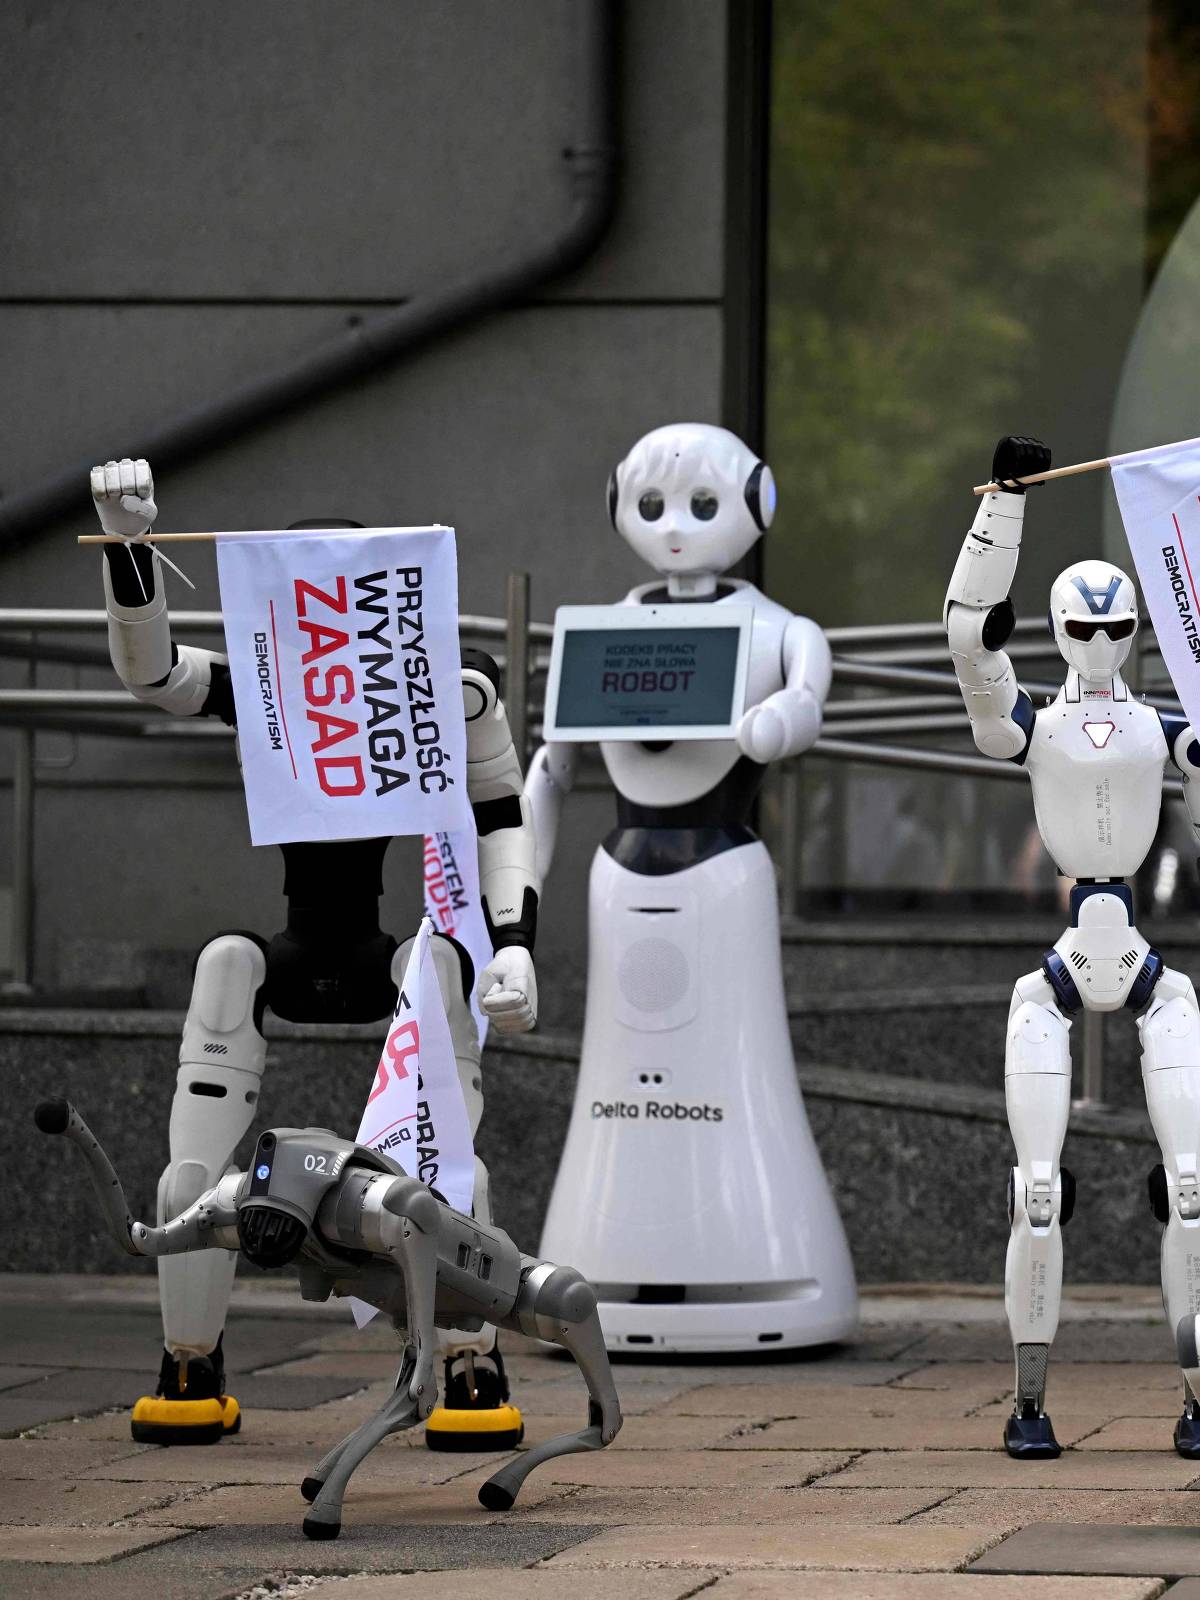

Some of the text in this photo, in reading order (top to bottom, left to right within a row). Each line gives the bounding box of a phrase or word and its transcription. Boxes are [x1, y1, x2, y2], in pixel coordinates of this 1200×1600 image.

[253, 632, 284, 751] DEMOCRATISM
[294, 575, 366, 797] ZASAD
[353, 569, 411, 797] WYMAGA
[396, 566, 455, 794] PRZYSZŁOŚĆ
[602, 671, 696, 692] ROBOT
[304, 1154, 327, 1173] 02
[591, 1101, 724, 1122] Delta Robots
